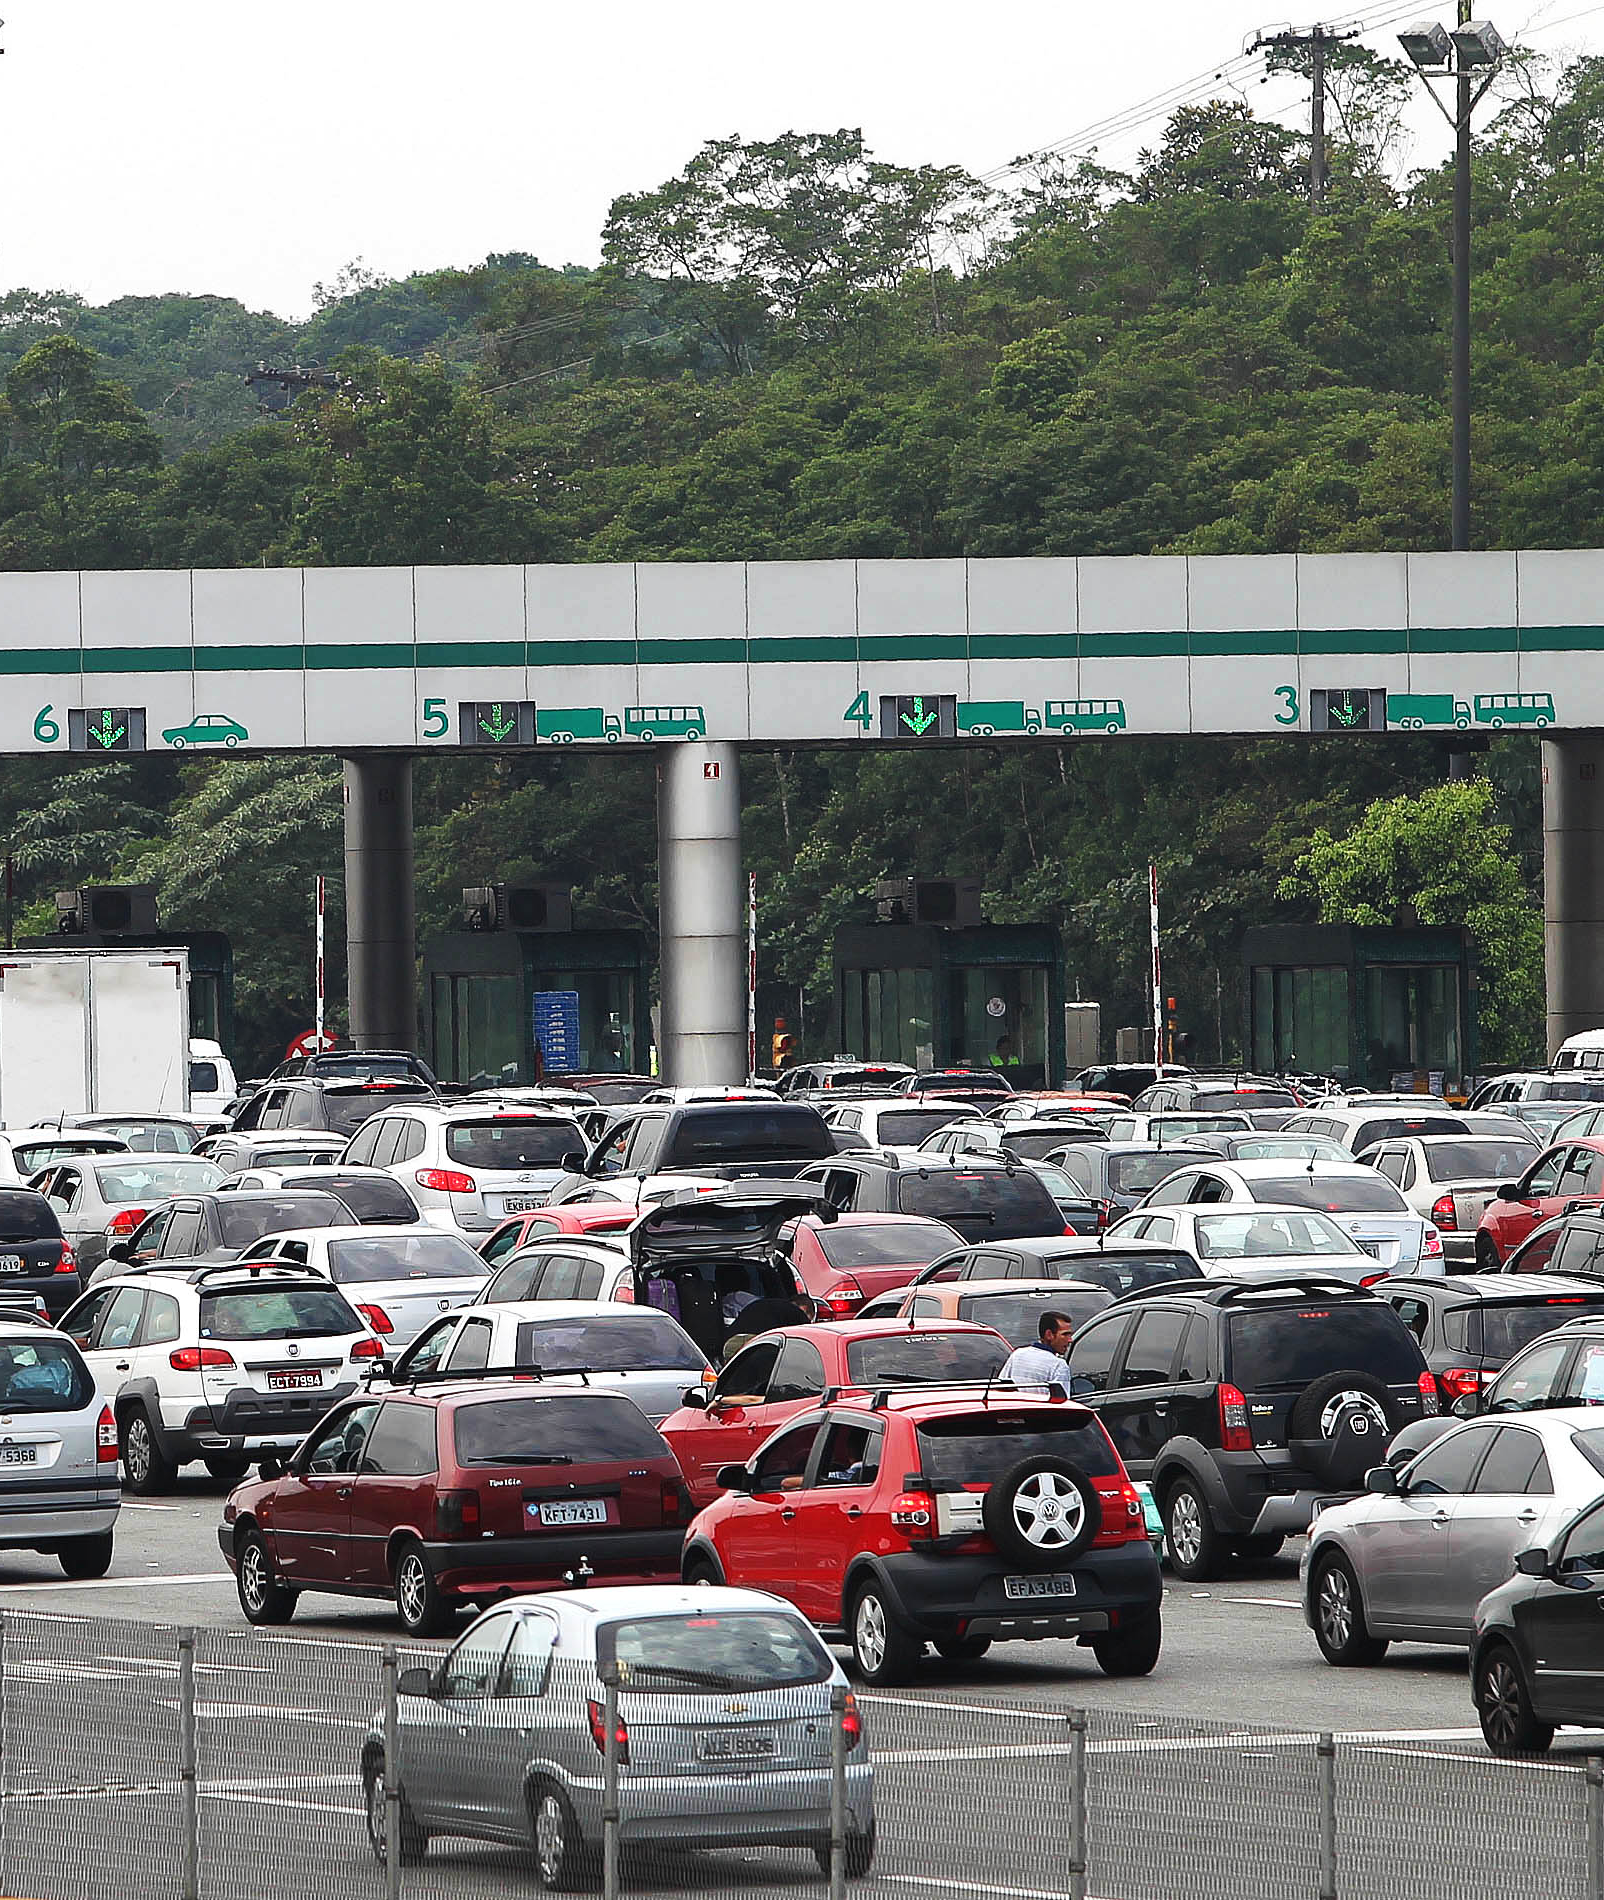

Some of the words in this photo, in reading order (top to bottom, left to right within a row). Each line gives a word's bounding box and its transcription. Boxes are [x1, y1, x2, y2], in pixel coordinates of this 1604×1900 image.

[33, 704, 61, 744] 6
[423, 698, 449, 738] 5
[842, 690, 873, 731] 4
[1274, 684, 1301, 725] 3
[269, 1374, 322, 1389] ECT-7994
[544, 1508, 601, 1523] KFT-7431
